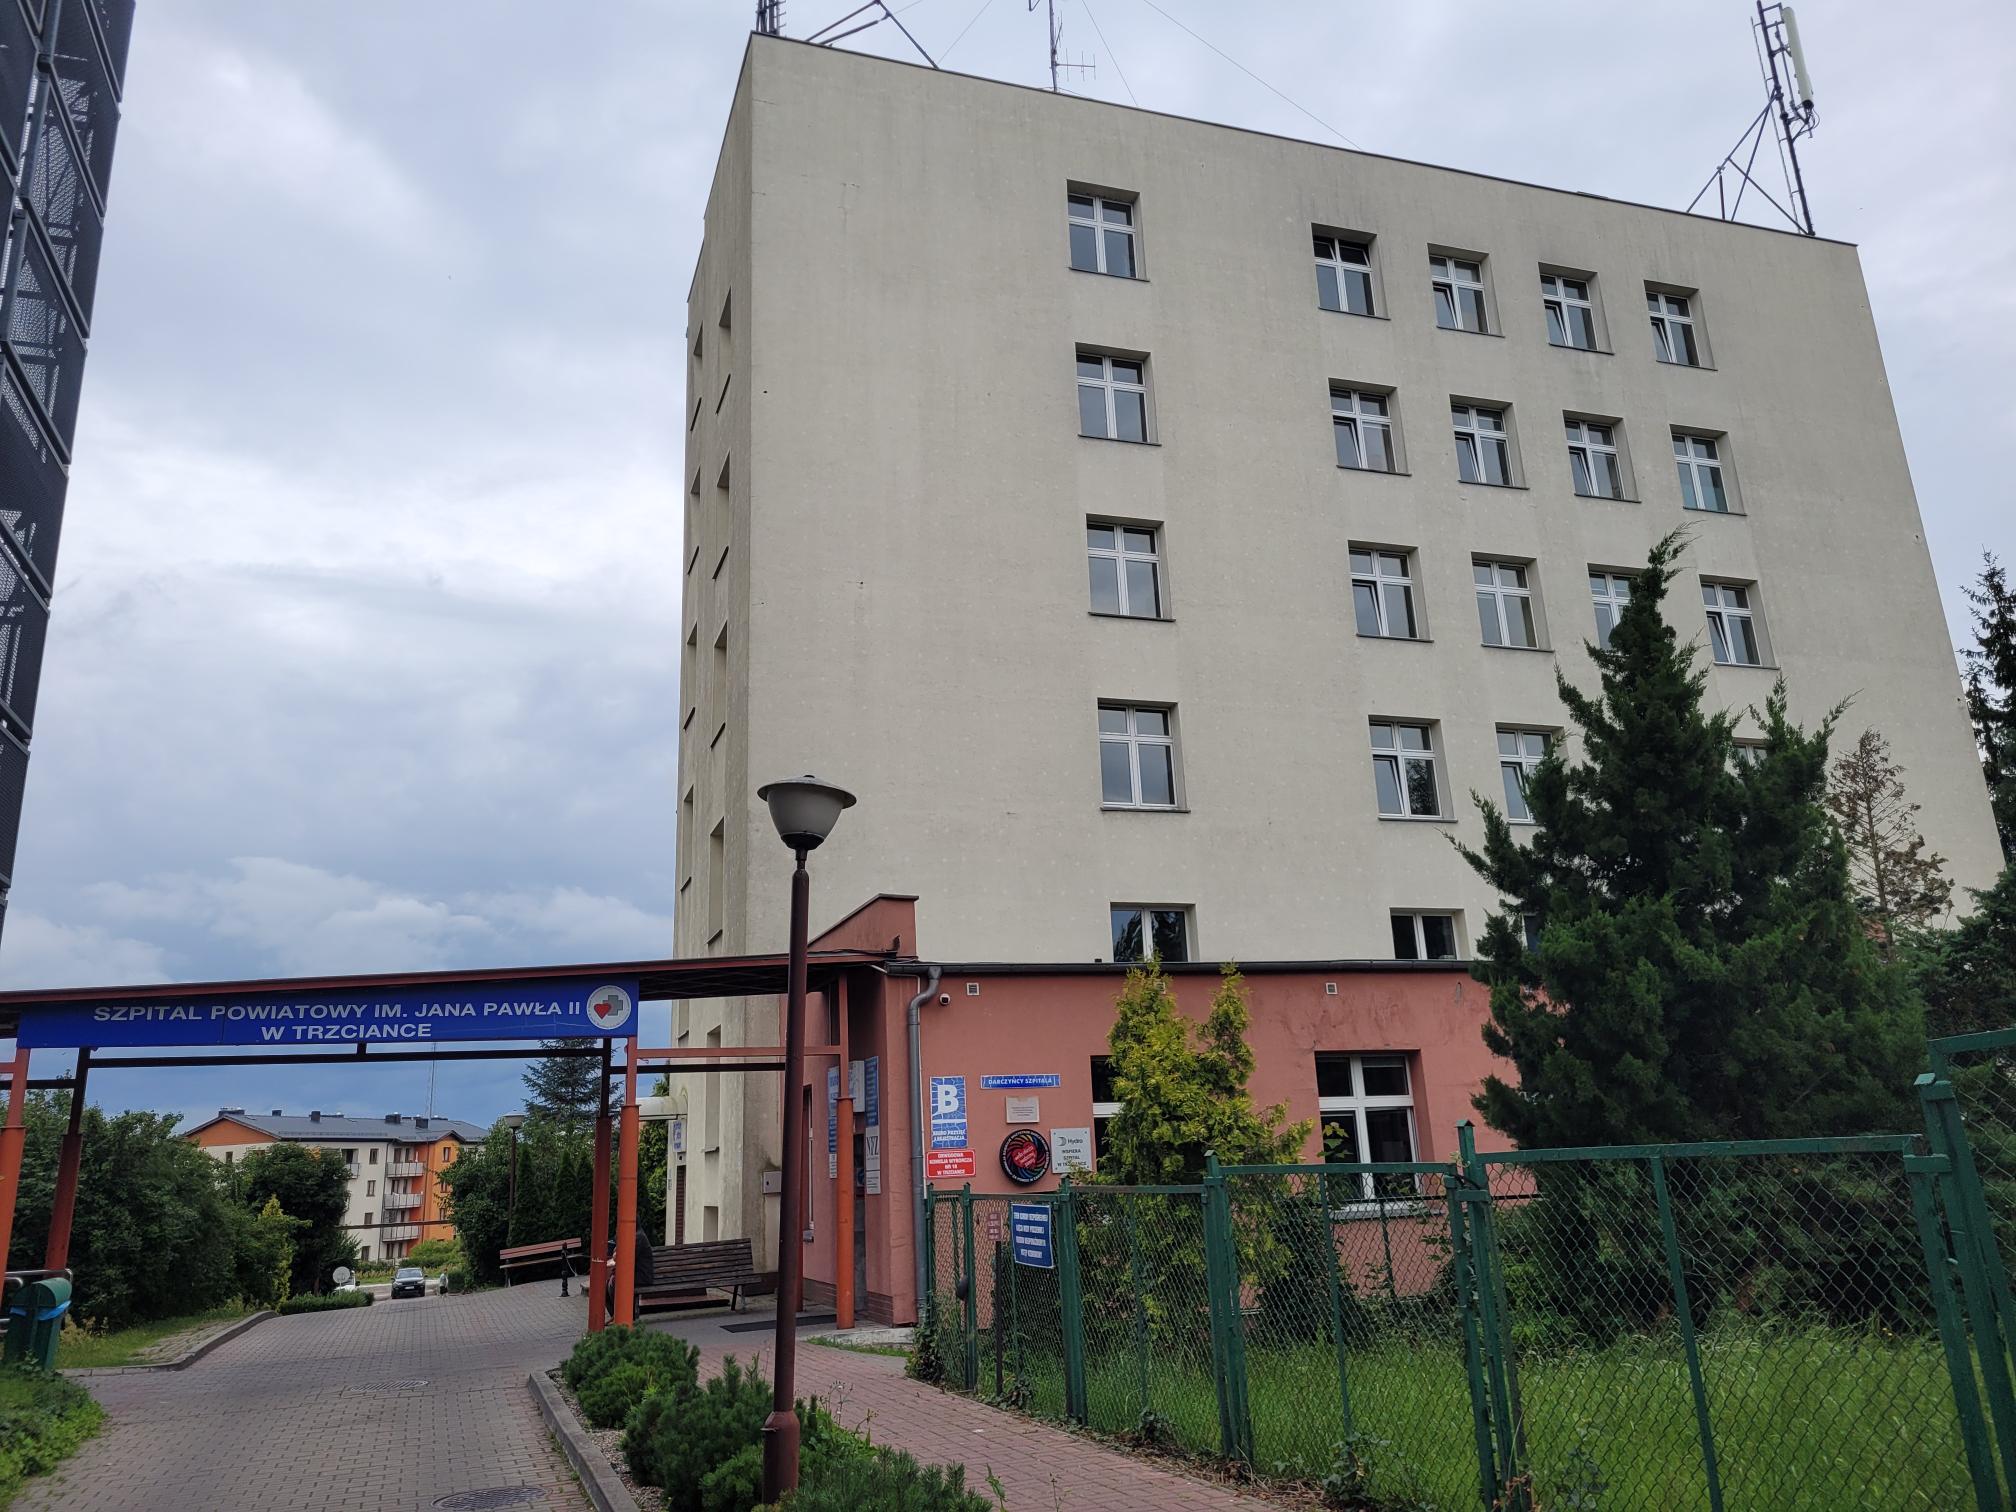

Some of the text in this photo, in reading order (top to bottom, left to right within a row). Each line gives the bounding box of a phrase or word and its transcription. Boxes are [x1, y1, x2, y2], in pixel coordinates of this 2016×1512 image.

[93, 1001, 580, 1021] SZPITAL POWIATOWY IM. JANA PAWŁA II
[261, 1023, 432, 1041] W TRZCIANCE
[937, 1084, 959, 1114] B
